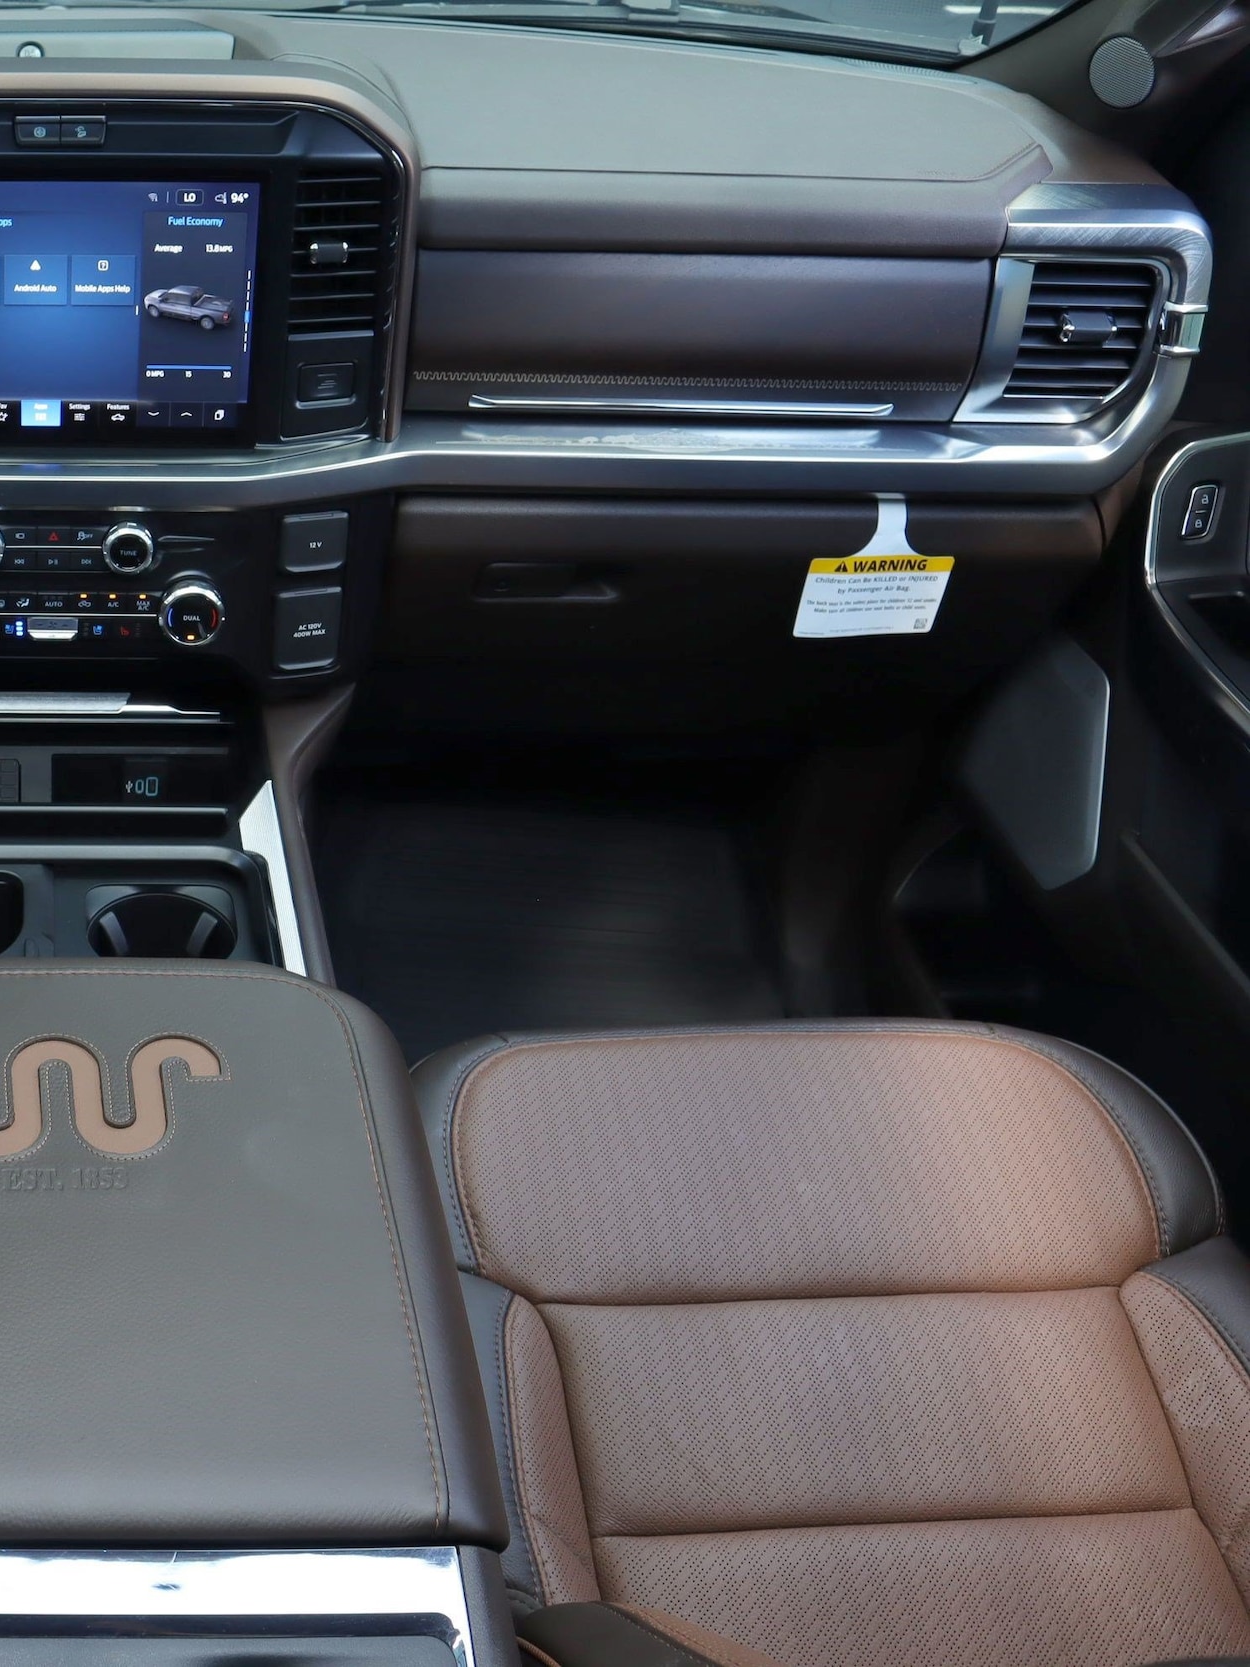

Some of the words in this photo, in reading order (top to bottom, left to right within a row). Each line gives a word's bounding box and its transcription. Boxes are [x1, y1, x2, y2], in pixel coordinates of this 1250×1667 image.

[183, 193, 197, 203] LO
[167, 216, 186, 226] Fuel
[186, 216, 224, 228] Economy
[154, 244, 183, 254] Average
[13, 284, 40, 292] Android
[40, 284, 58, 292] Auto
[74, 284, 97, 293] Mobile
[97, 284, 114, 294] Apps
[114, 284, 131, 294] Help
[68, 402, 91, 411] Settings
[106, 403, 130, 411] Features
[853, 559, 928, 573] WARNING
[815, 576, 847, 584] Children
[907, 575, 939, 583] INJURED
[837, 587, 846, 595] by
[847, 586, 883, 594] Passenger
[895, 585, 911, 593] Bag.
[1, 1168, 64, 1191] EST.
